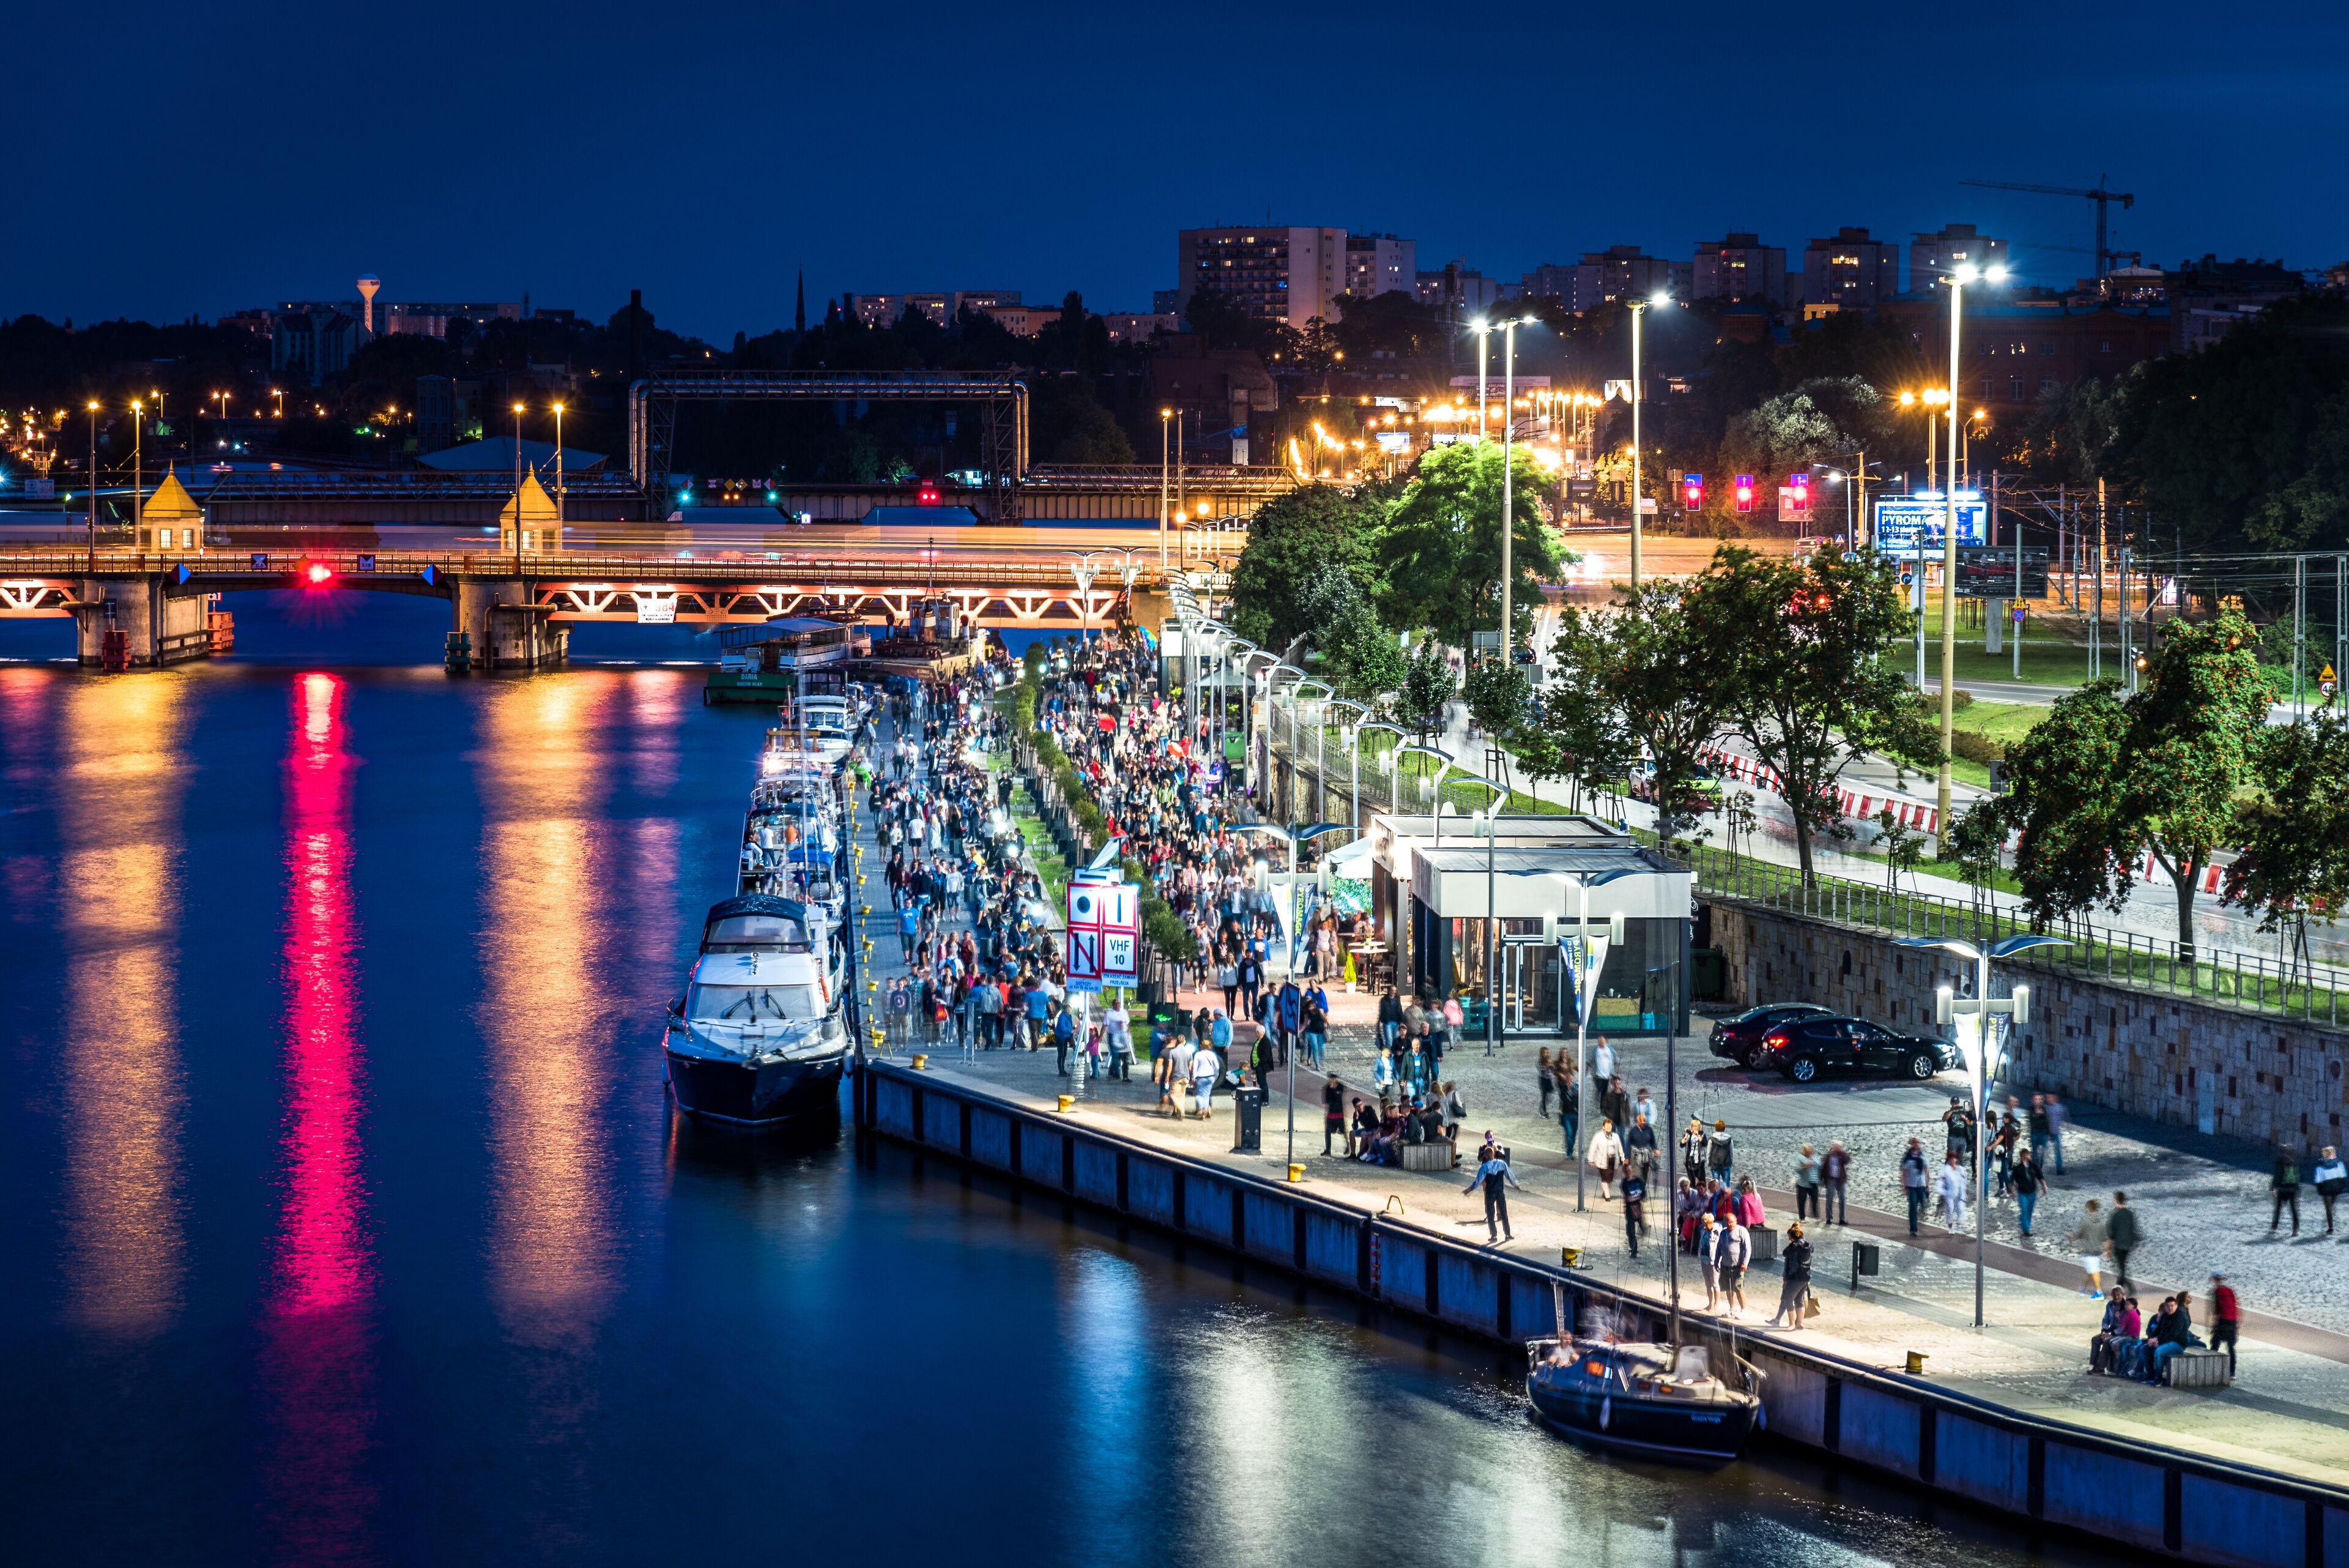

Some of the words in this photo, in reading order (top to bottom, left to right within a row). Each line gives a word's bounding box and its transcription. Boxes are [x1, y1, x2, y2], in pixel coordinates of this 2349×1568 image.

[1882, 515, 1944, 525] PYROM
[1295, 887, 1304, 937] PYROMAGIC
[1110, 939, 1129, 952] VHF
[1114, 955, 1124, 965] 10
[1986, 1017, 1997, 1080] PYRGIC
